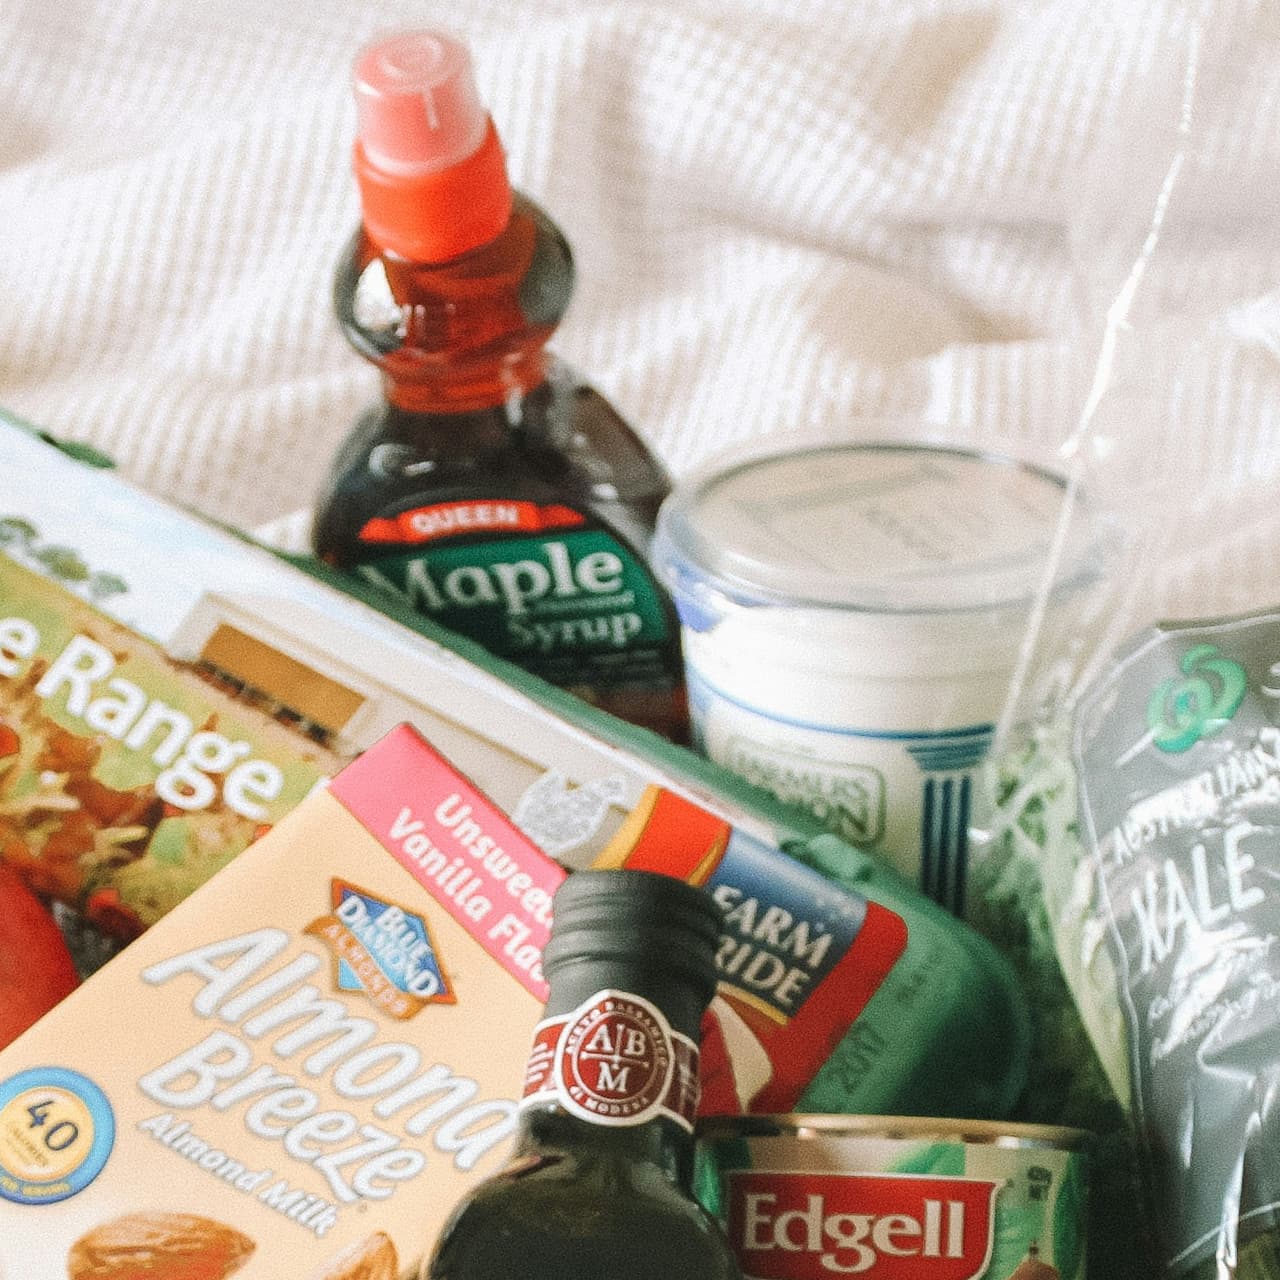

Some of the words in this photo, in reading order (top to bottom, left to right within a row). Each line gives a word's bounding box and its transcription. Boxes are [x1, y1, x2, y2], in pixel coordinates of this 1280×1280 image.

[410, 503, 519, 534] QUEEN
[357, 542, 623, 614] Maple
[508, 612, 642, 649] Syrup
[35, 634, 286, 819] Range
[389, 808, 492, 922] Vanilla
[26, 1100, 79, 1151] 40
[138, 1030, 427, 1204] Breeze
[139, 1114, 268, 1207] Almond
[264, 1181, 339, 1237] Milk
[744, 1194, 965, 1273] Edgell
